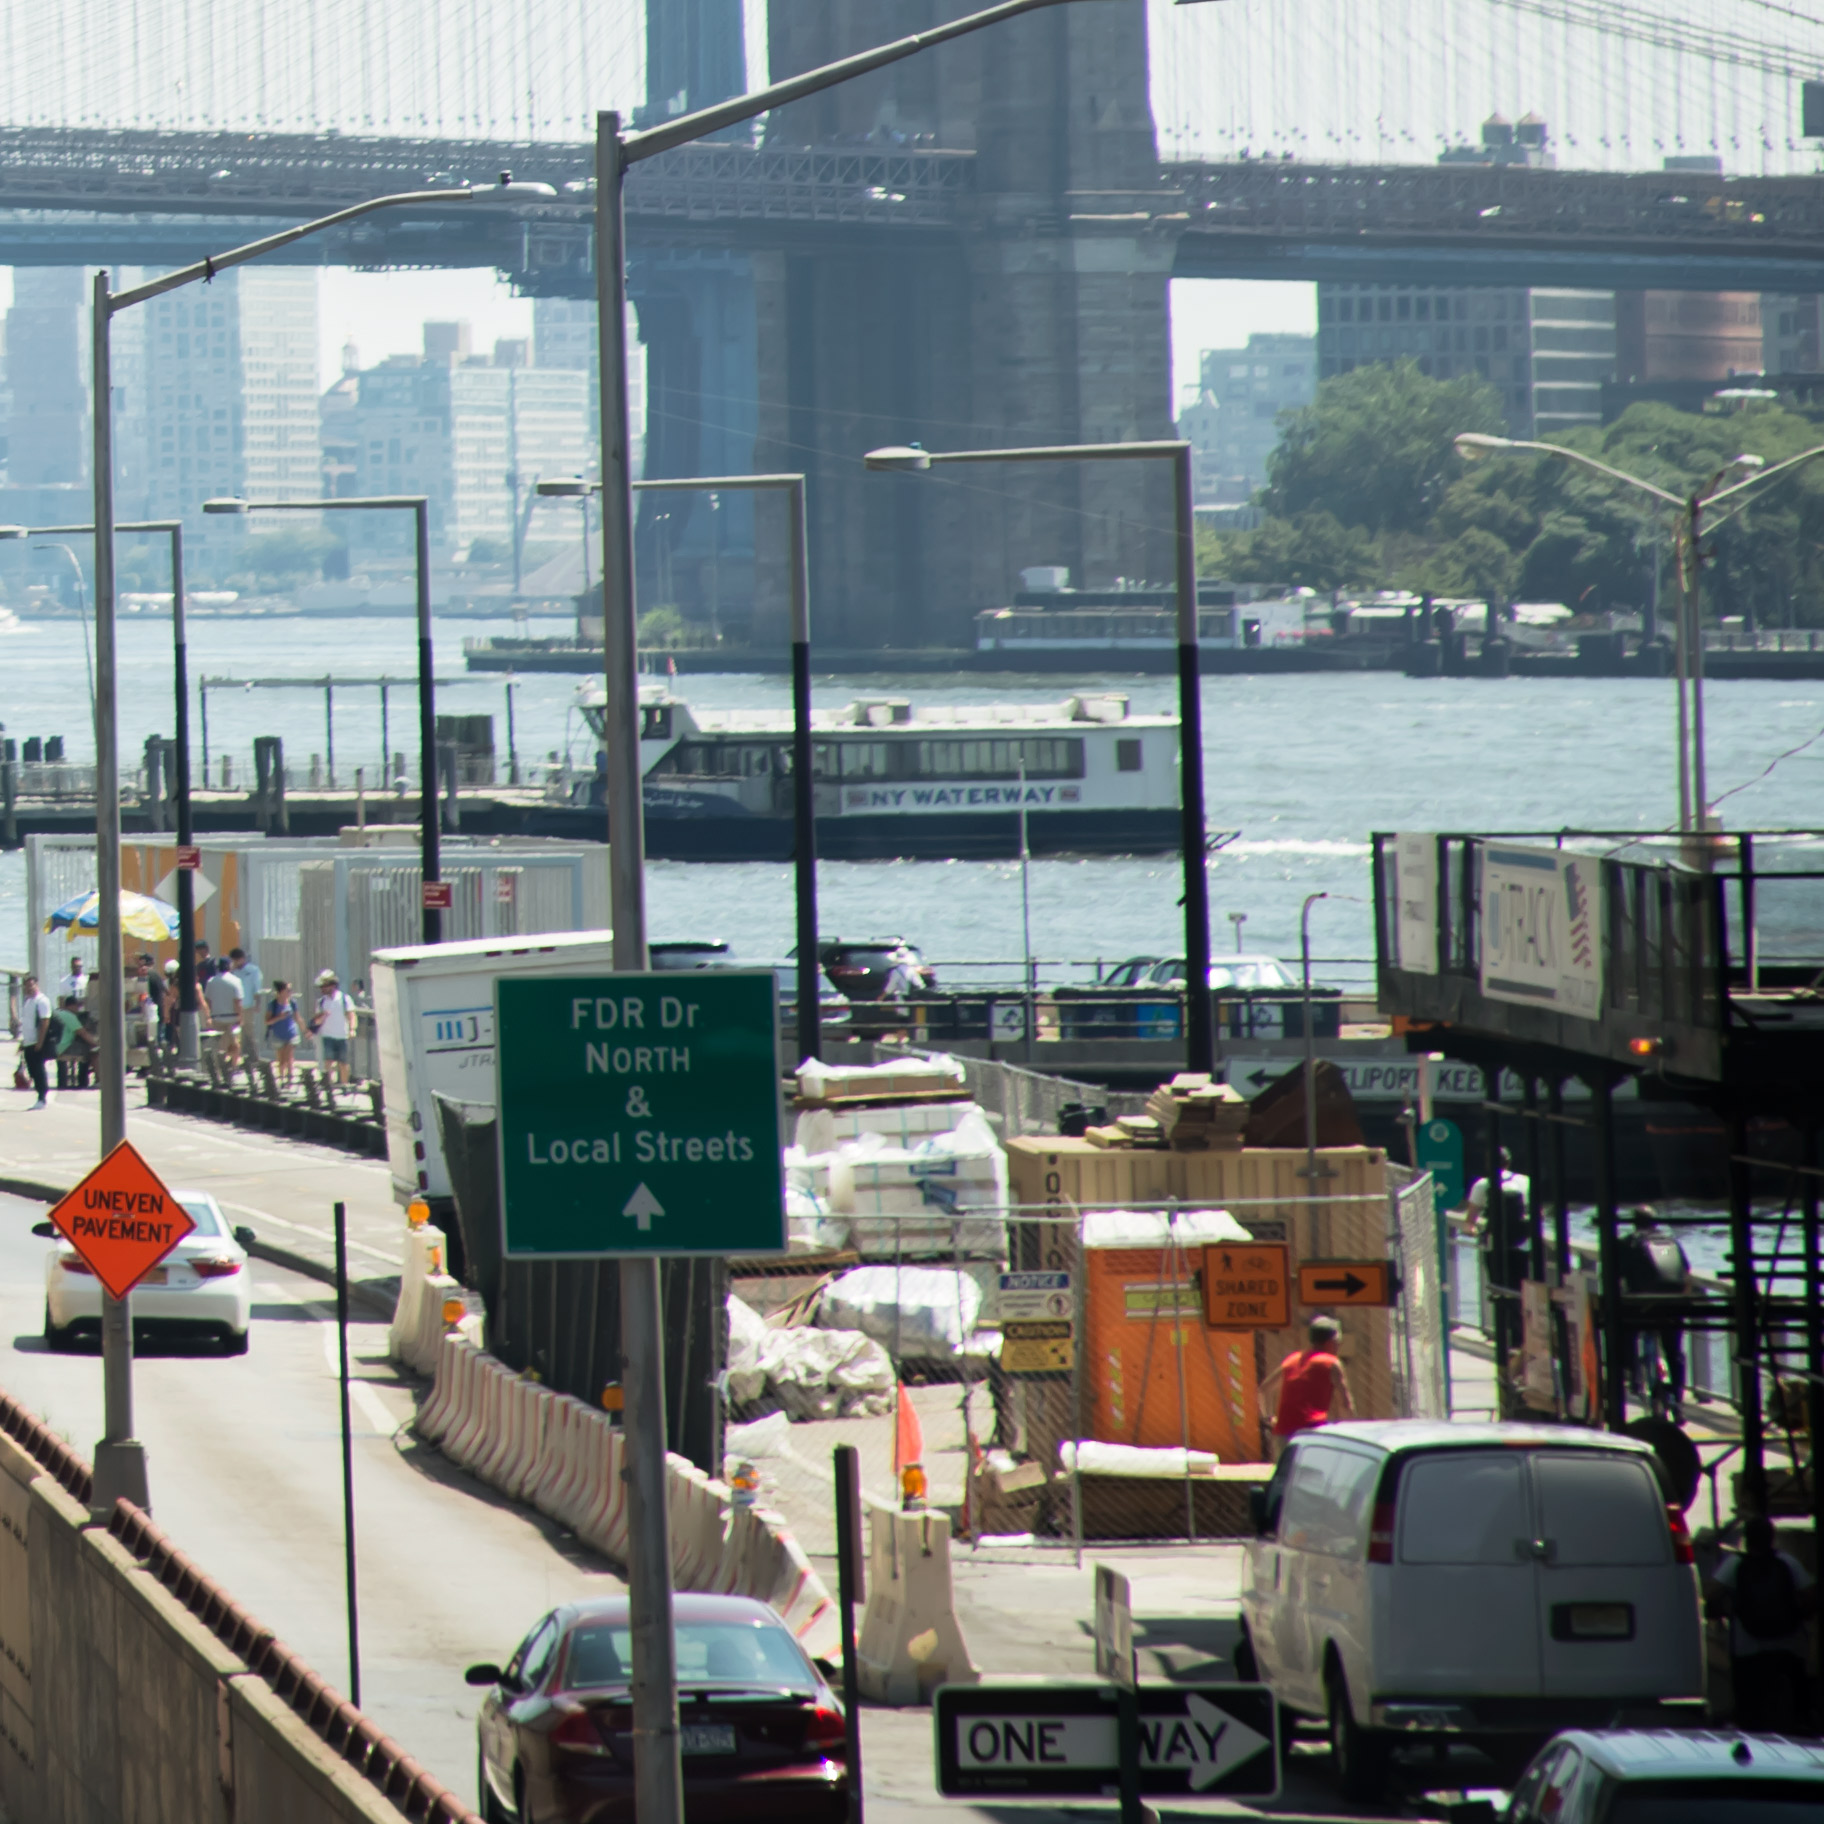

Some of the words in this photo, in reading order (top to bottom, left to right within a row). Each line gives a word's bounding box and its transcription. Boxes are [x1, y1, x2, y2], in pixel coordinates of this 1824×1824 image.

[871, 789, 906, 806] NY
[912, 785, 1055, 804] WATERWAY
[571, 997, 645, 1029] FDR
[660, 996, 700, 1028] Dr
[1437, 1066, 1484, 1092] KEE
[625, 1086, 653, 1118] &
[527, 1132, 621, 1164] Local
[635, 1130, 754, 1163] Streets
[84, 1189, 163, 1214] UNEVEN
[73, 1215, 174, 1244] PAVEMENT
[1007, 1274, 1060, 1289] NOTICE
[1216, 1279, 1279, 1296] SHARED
[1227, 1301, 1268, 1318] ZONE
[968, 1721, 1067, 1764] ONE
